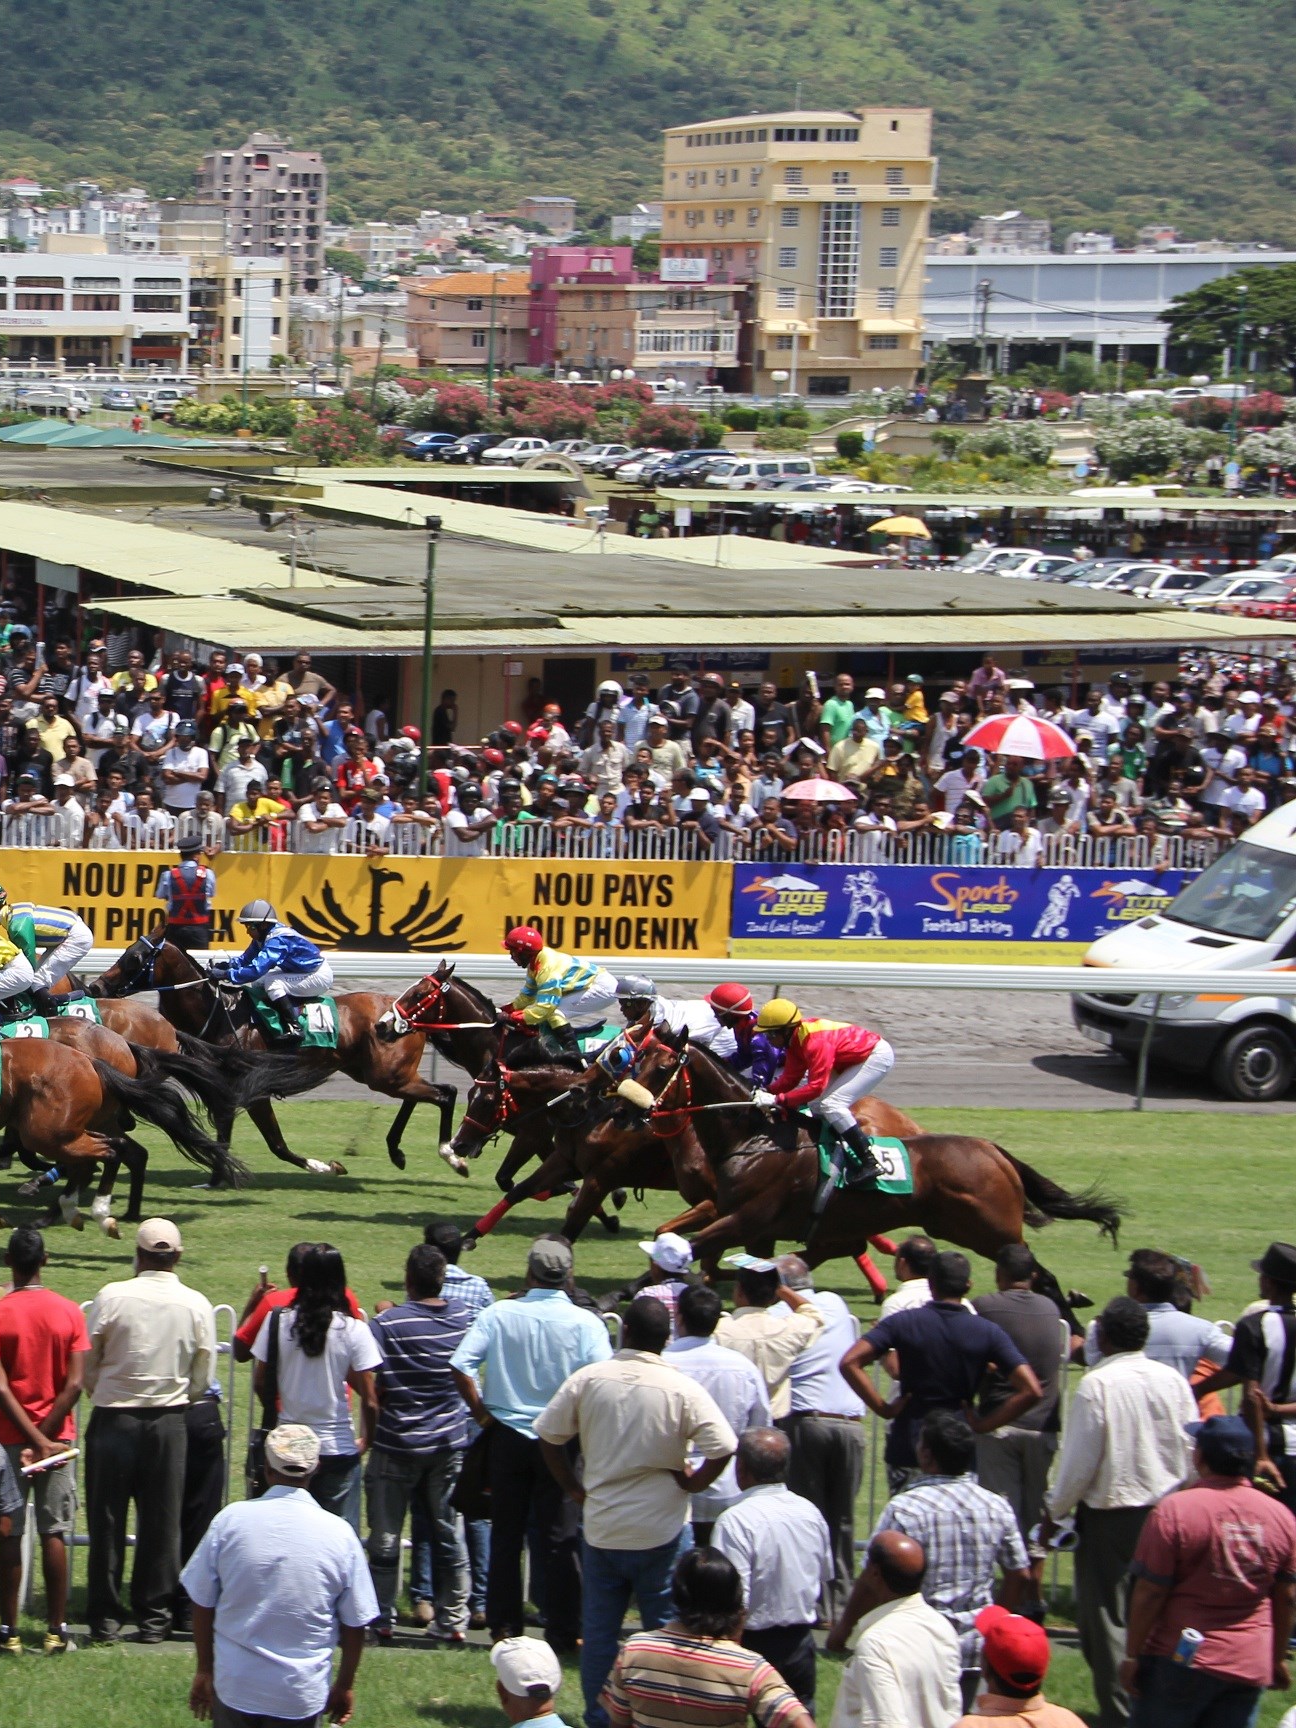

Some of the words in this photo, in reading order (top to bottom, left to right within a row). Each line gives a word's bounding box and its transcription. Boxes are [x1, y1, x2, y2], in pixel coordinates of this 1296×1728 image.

[63, 862, 125, 897] NOU
[533, 872, 594, 907] NOU
[604, 874, 673, 908] PAYS
[758, 903, 826, 917] LEPEP
[777, 891, 829, 903] TOTE
[573, 916, 699, 950] PHOENIX
[881, 1150, 896, 1176] 5
